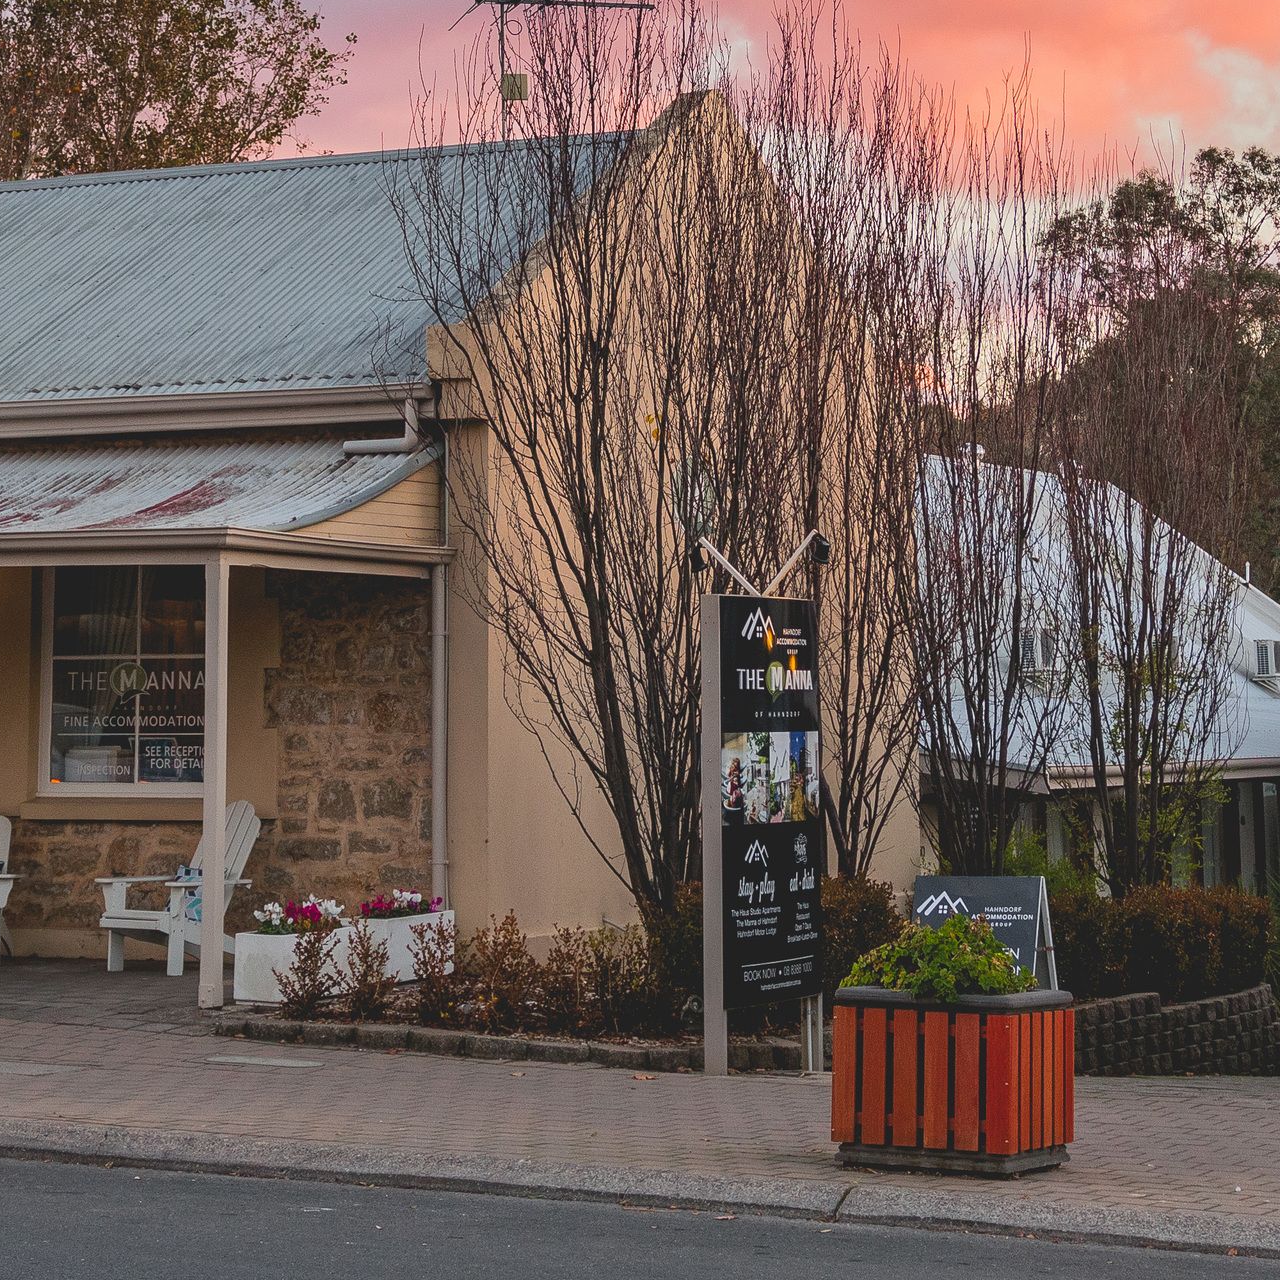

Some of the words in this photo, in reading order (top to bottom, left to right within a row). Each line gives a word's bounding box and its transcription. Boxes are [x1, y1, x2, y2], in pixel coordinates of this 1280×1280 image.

[68, 671, 108, 691] THE
[120, 669, 205, 691] MANNA
[736, 669, 765, 690] THE
[771, 667, 813, 691] MANNA
[64, 716, 89, 727] FINE
[92, 715, 205, 727] ACCOMMODATION
[145, 746, 162, 756] SEE
[150, 758, 171, 769] FOR
[77, 765, 131, 776] INSPECTION
[759, 872, 776, 903] play
[731, 909, 739, 917] The
[740, 908, 749, 916] Haus
[736, 919, 744, 927] The
[736, 929, 754, 938] Hahndorf
[766, 927, 777, 935] Lodge
[744, 970, 761, 982] BOOK
[762, 968, 776, 979] NOW
